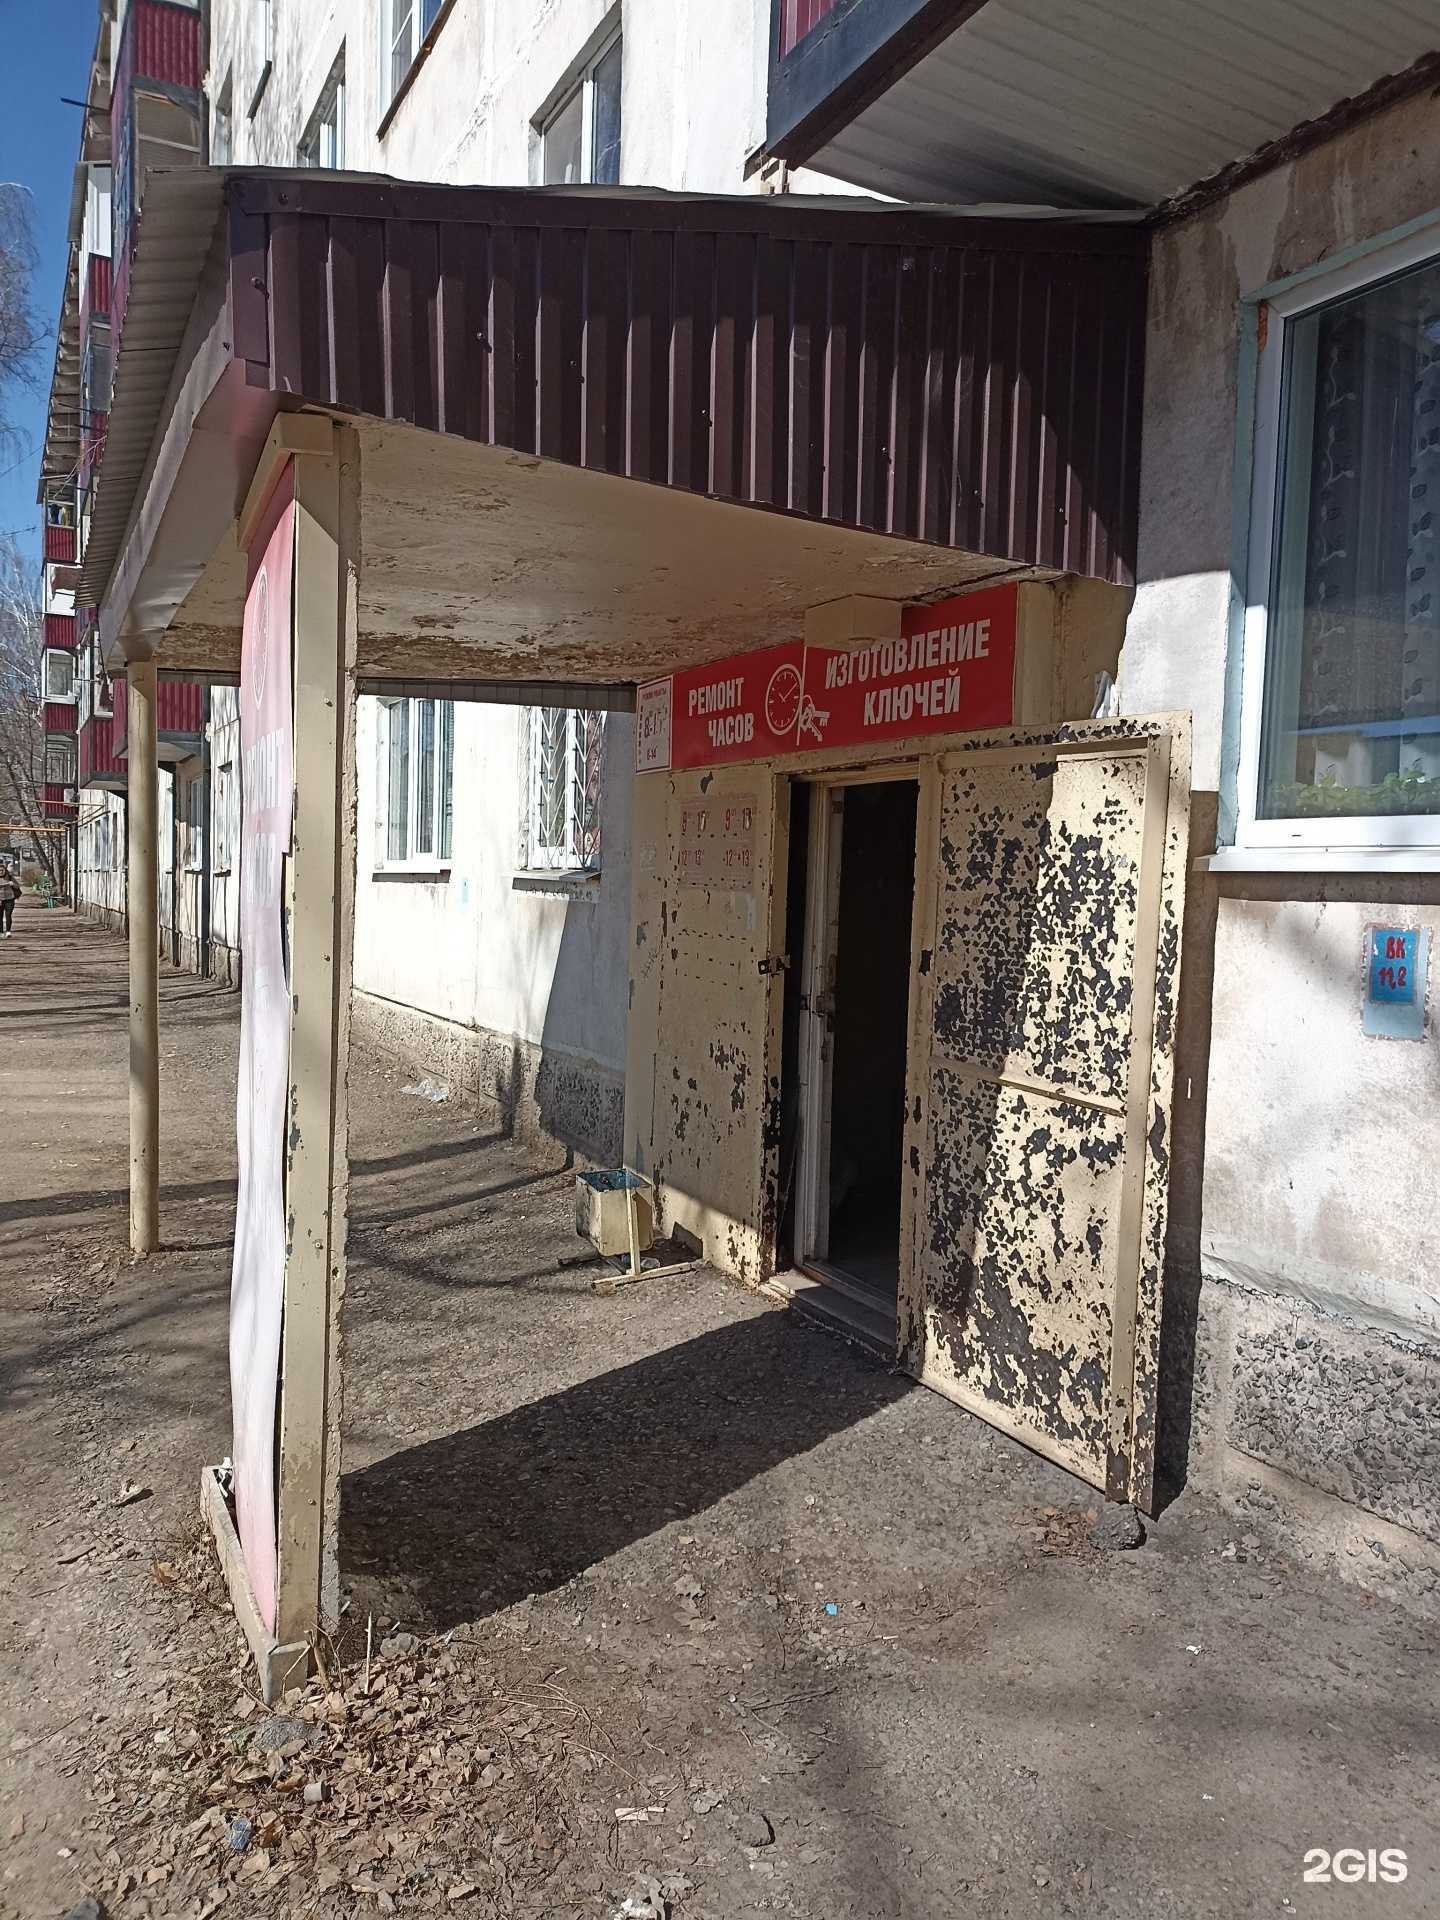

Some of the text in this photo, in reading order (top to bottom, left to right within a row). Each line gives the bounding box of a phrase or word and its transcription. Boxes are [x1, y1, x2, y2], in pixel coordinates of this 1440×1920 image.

[825, 619, 991, 689] ИЗГОТОВЛЕНИЕ
[688, 677, 745, 717] РЕМОНТ
[863, 668, 961, 726] КЛЮЧЕЙ
[708, 713, 754, 747] ЧАСОВ
